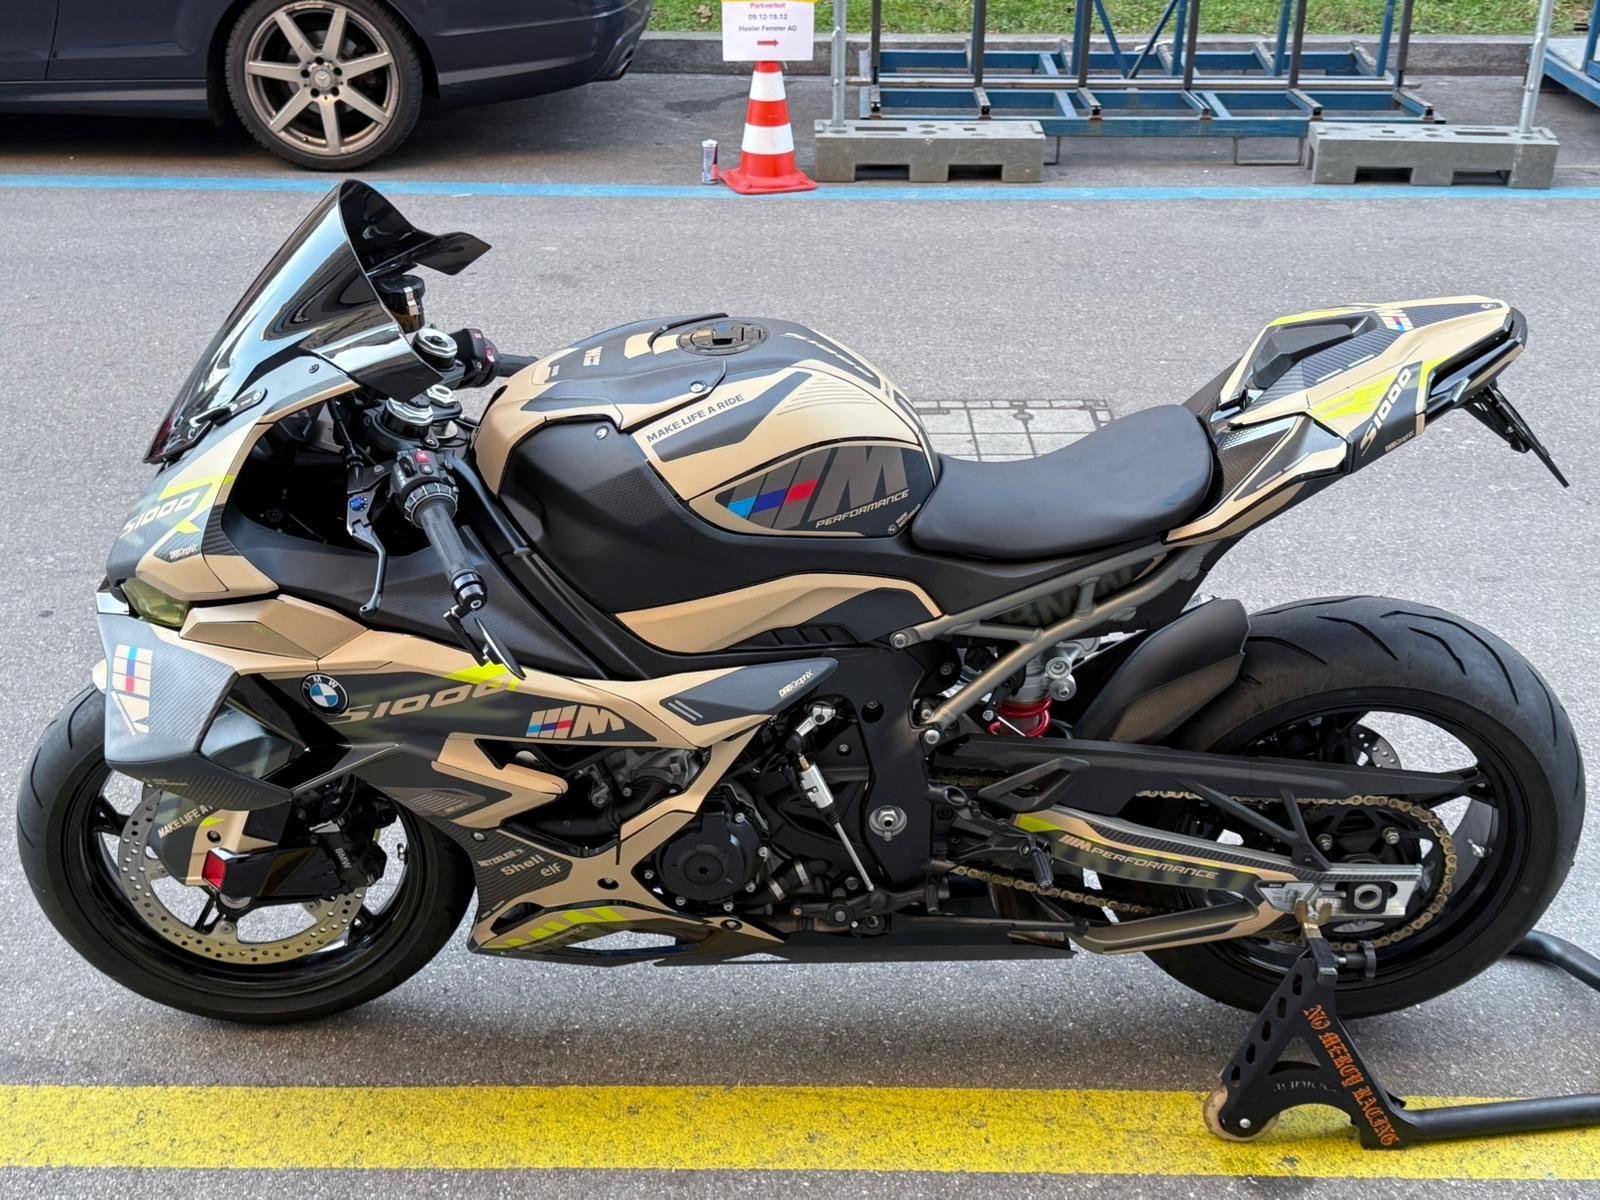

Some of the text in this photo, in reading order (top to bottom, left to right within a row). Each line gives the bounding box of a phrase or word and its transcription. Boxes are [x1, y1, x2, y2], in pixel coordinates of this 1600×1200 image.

[646, 393, 745, 443] MAKE LIFE A RIDE
[1359, 367, 1413, 457] S1000
[119, 492, 200, 540] S1000
[815, 488, 910, 529] PERFORMANCE
[157, 820, 182, 840] MAKE
[180, 809, 200, 825] LIFE
[334, 846, 352, 869] BMW
[500, 853, 545, 877] Shell
[540, 863, 564, 878] elf
[1090, 847, 1220, 880] PERFORMANCE
[1302, 1004, 1333, 1030] NO
[1318, 1032, 1366, 1088] MERCY
[1352, 1085, 1401, 1147] RACING
